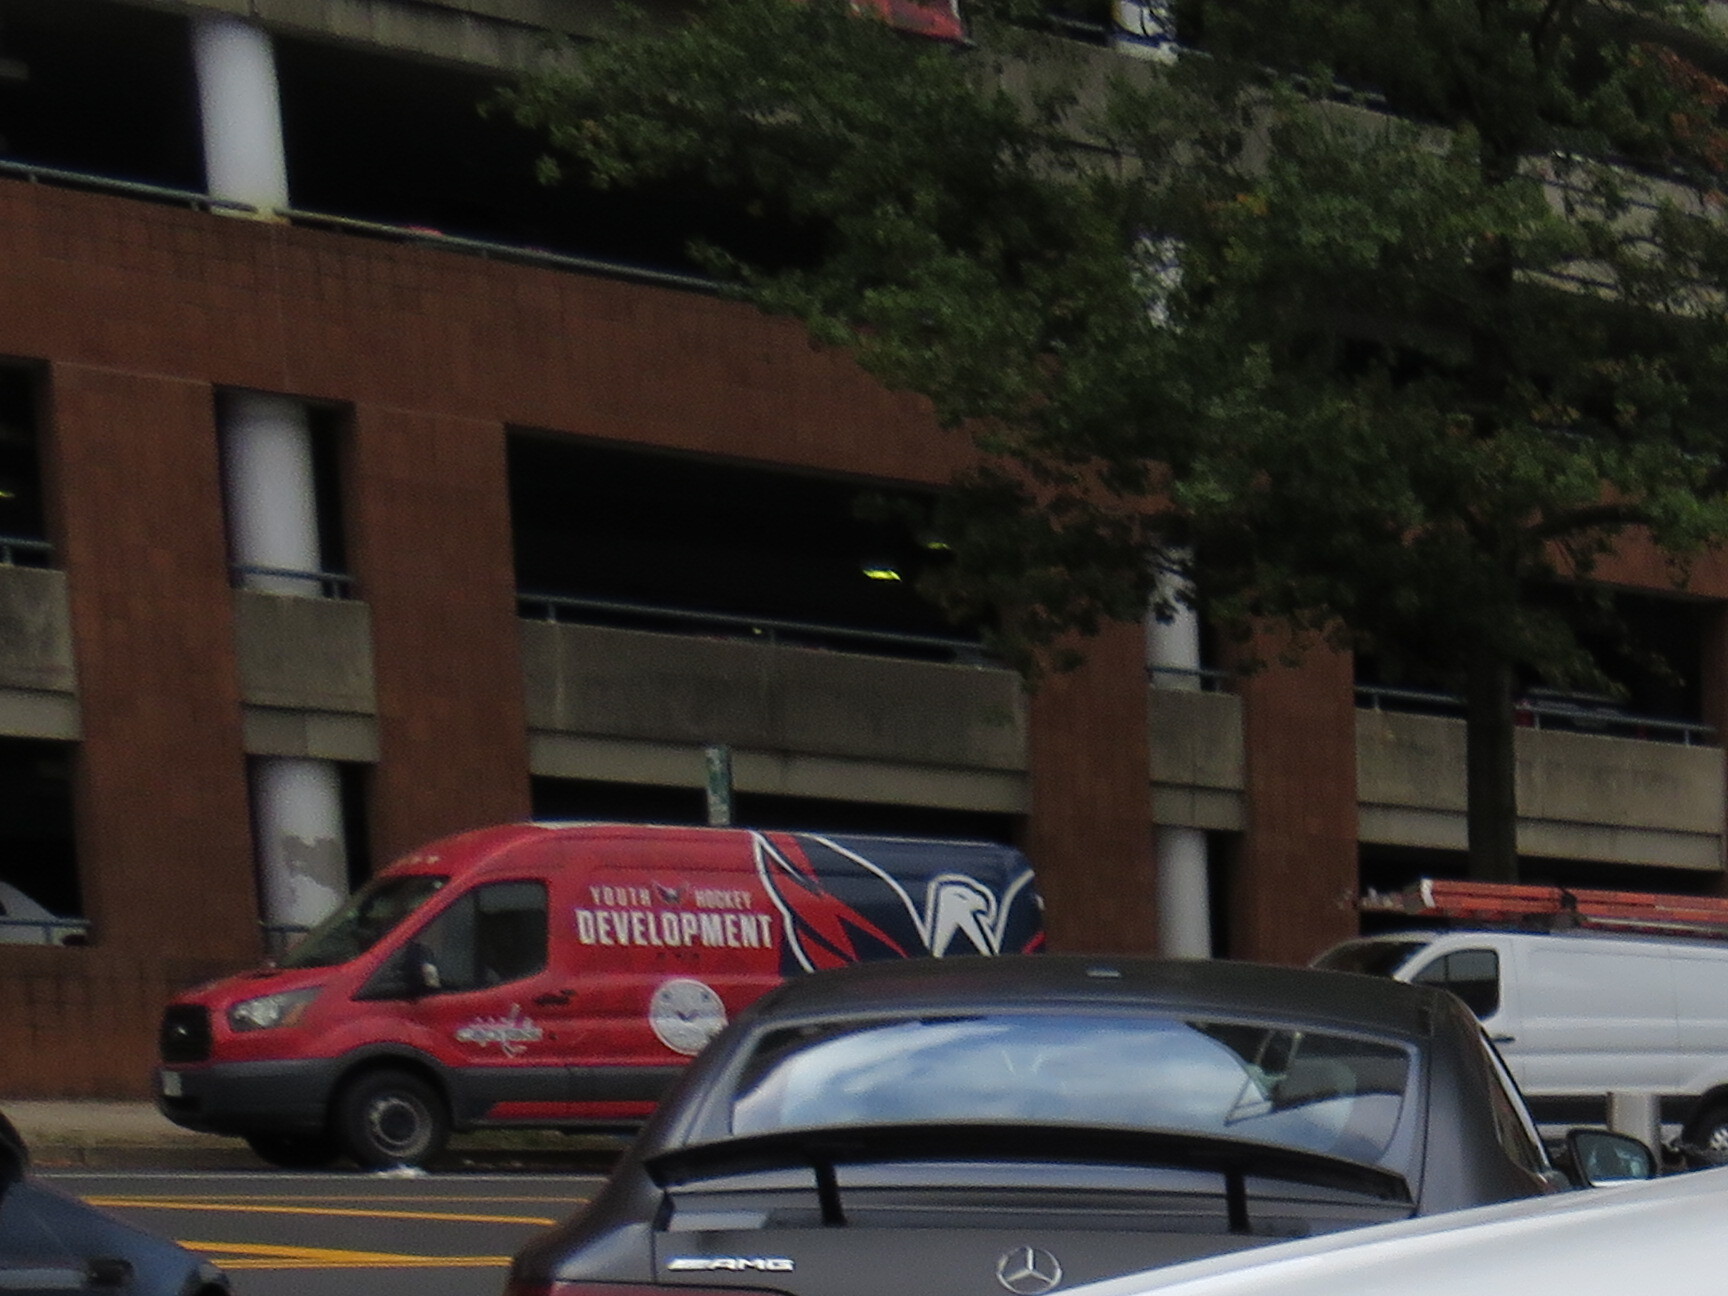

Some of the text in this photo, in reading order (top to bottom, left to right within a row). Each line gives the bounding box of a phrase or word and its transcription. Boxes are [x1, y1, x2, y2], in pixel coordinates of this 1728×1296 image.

[588, 886, 753, 909] YOUTH HOCKEY
[575, 908, 774, 948] DEVELOPMENT
[707, 1258, 796, 1271] AMG
